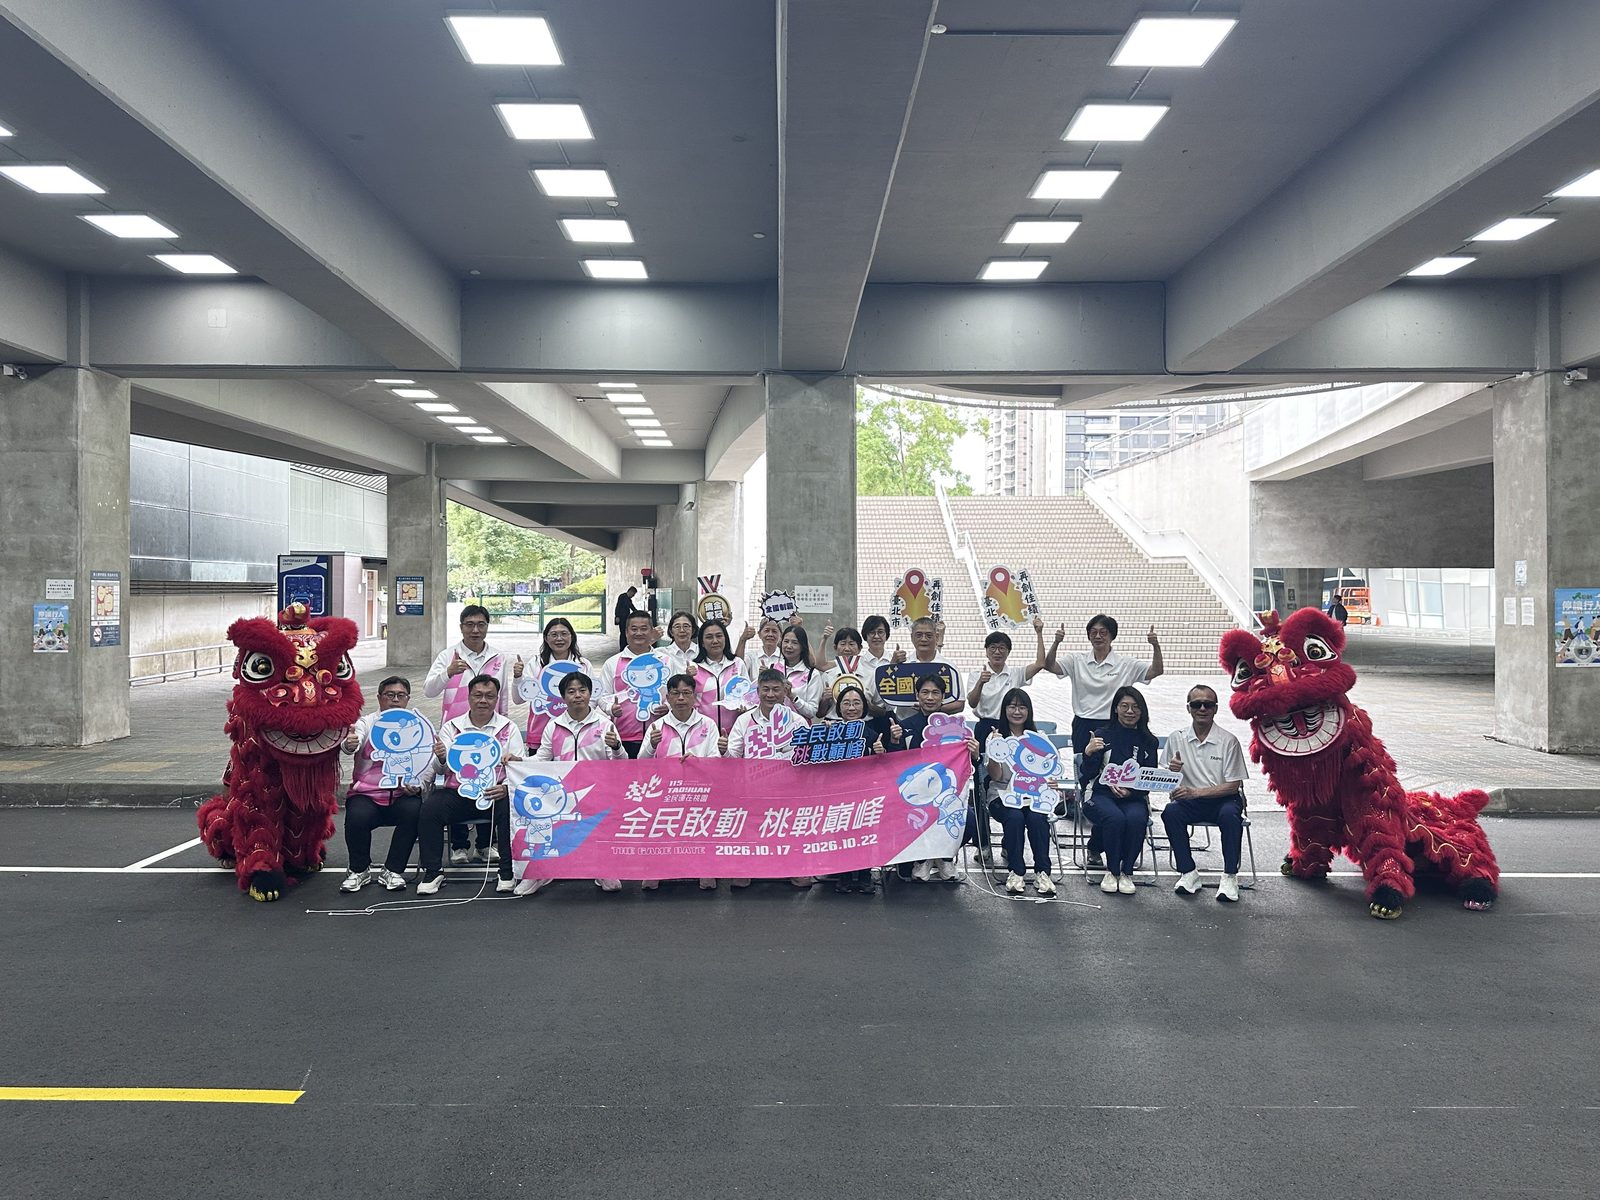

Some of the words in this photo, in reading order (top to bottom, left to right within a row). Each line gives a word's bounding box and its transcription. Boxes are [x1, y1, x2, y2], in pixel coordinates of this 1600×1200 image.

[791, 721, 864, 746] 全民敢動
[669, 779, 684, 787] 115
[1140, 775, 1179, 784] TAOYUAN
[667, 786, 711, 794] TAOYUAN
[615, 806, 749, 839] 全民敢動
[611, 846, 636, 855] THE
[637, 846, 672, 856] GAME
[715, 845, 791, 856] 2026.10.17
[802, 833, 878, 854] 2026.10.22
